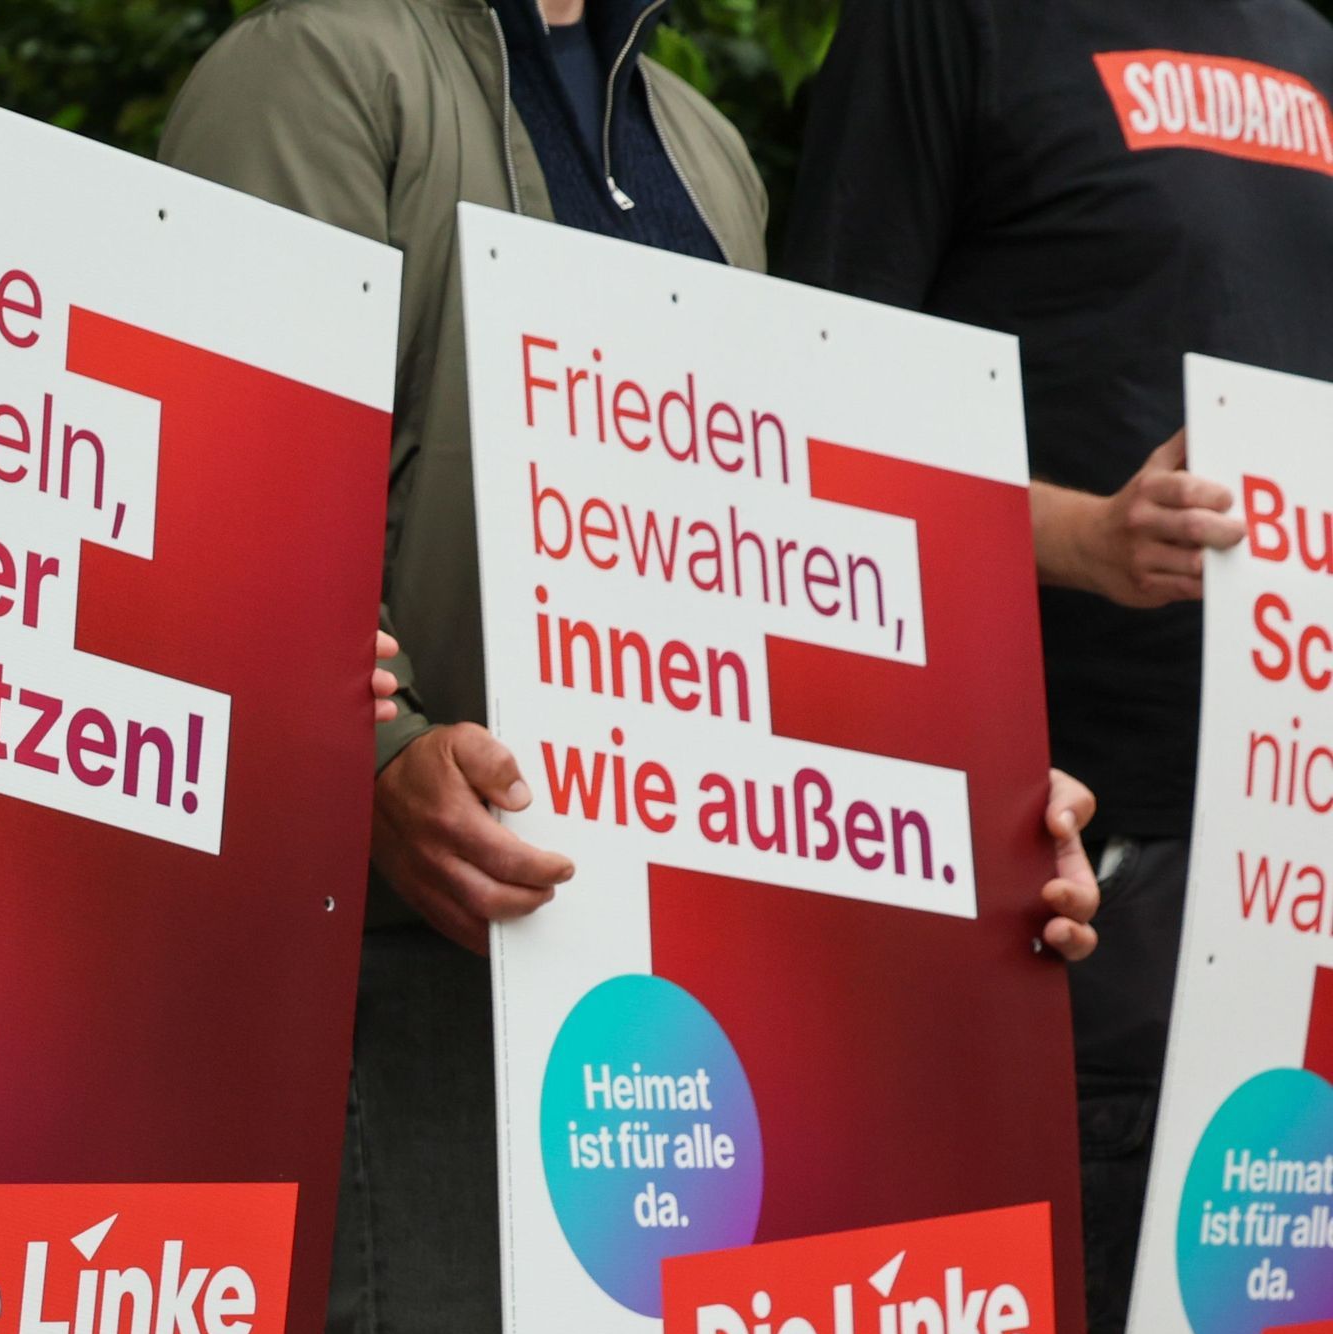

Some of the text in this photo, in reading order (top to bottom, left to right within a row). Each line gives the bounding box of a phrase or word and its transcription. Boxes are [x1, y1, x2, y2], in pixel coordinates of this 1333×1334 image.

[523, 335, 788, 482] Frieden
[531, 463, 902, 649] bewahren,
[536, 586, 750, 721] innen
[542, 728, 954, 883] wie außen.
[1238, 850, 1333, 937] wa
[585, 1064, 713, 1111] Heimat
[570, 1123, 735, 1169] ist für alle
[1225, 1151, 1333, 1194] Heimat
[635, 1183, 691, 1228] da.
[1202, 1203, 1333, 1248] ist für all
[1248, 1259, 1295, 1301] da.
